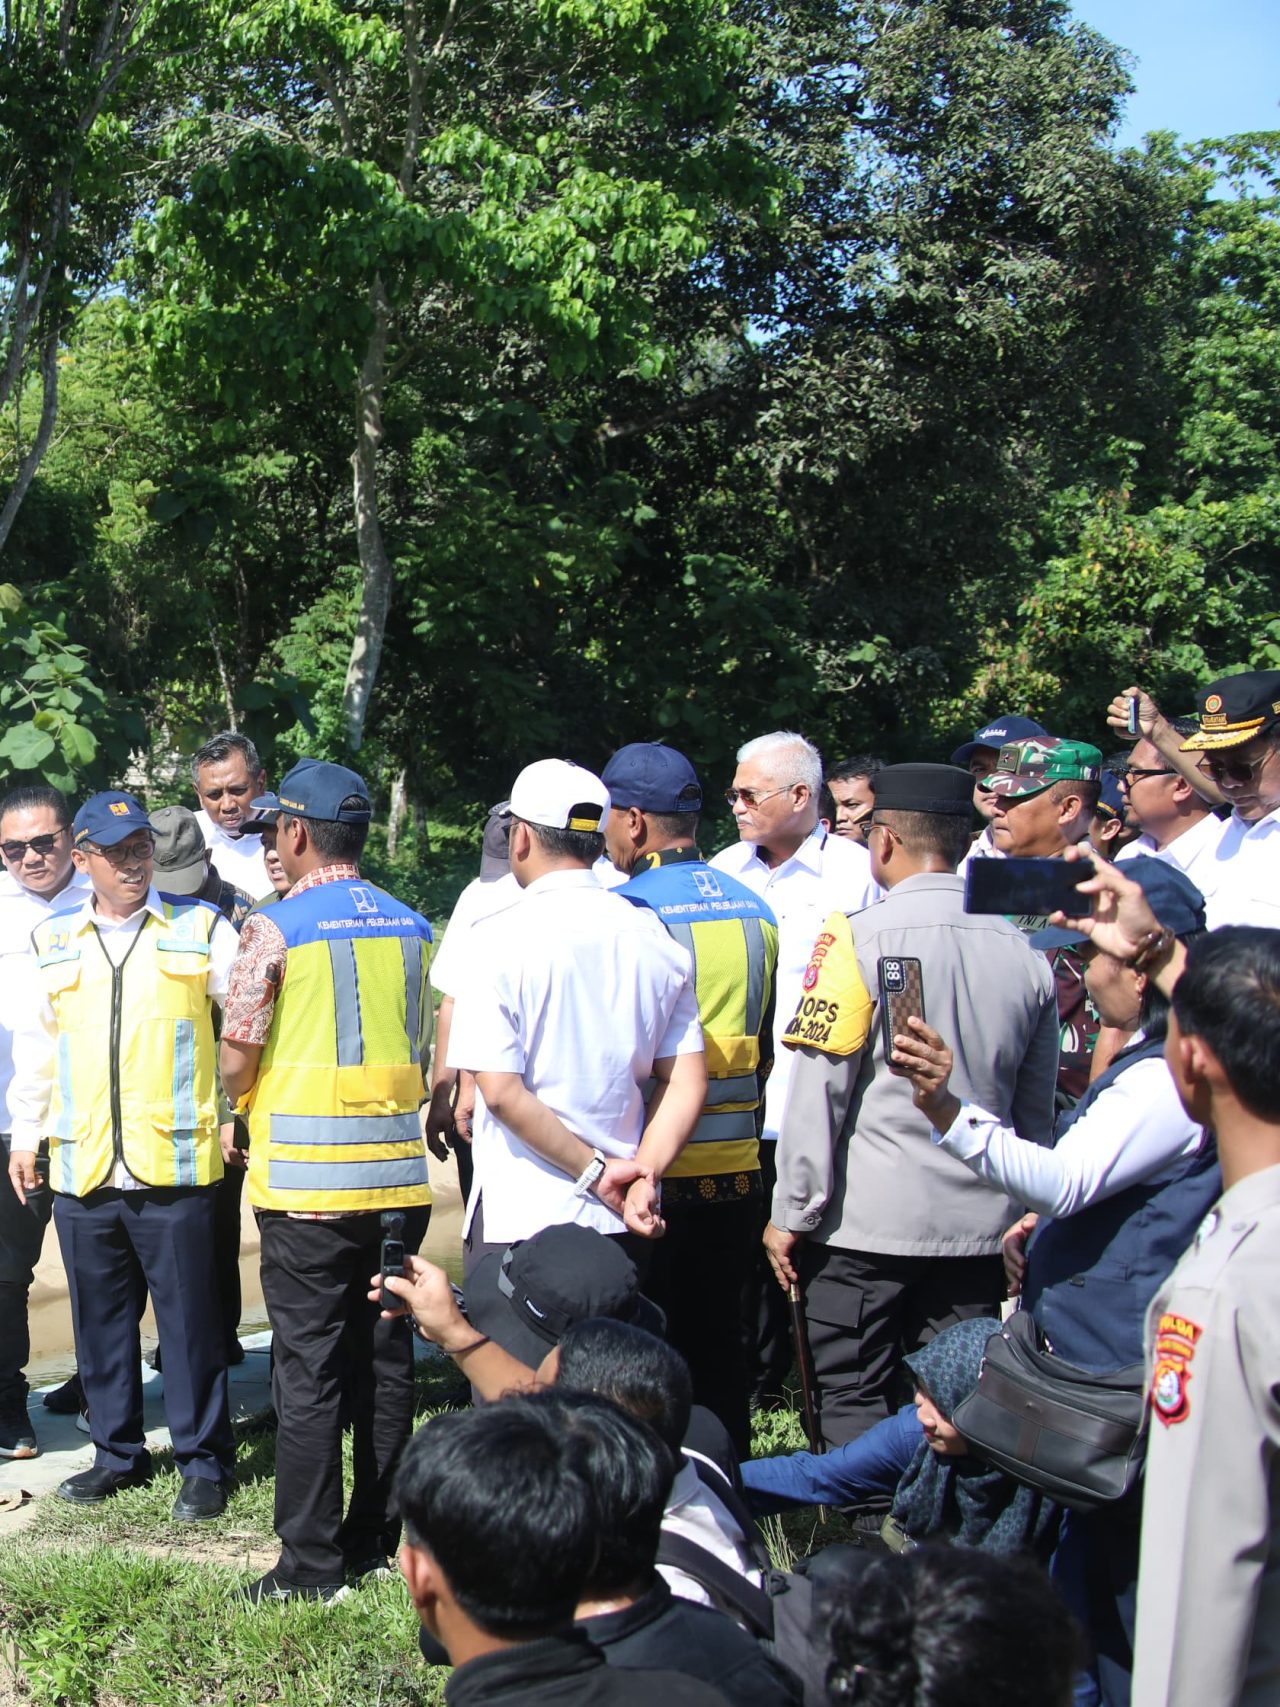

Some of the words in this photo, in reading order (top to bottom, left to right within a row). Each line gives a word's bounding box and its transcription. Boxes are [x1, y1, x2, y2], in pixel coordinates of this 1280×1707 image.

[660, 903, 708, 914] KEMENTERIAN
[318, 919, 364, 929] KEMENTERIAN
[367, 918, 400, 927] PEKERJAAN
[803, 997, 839, 1023] OPS
